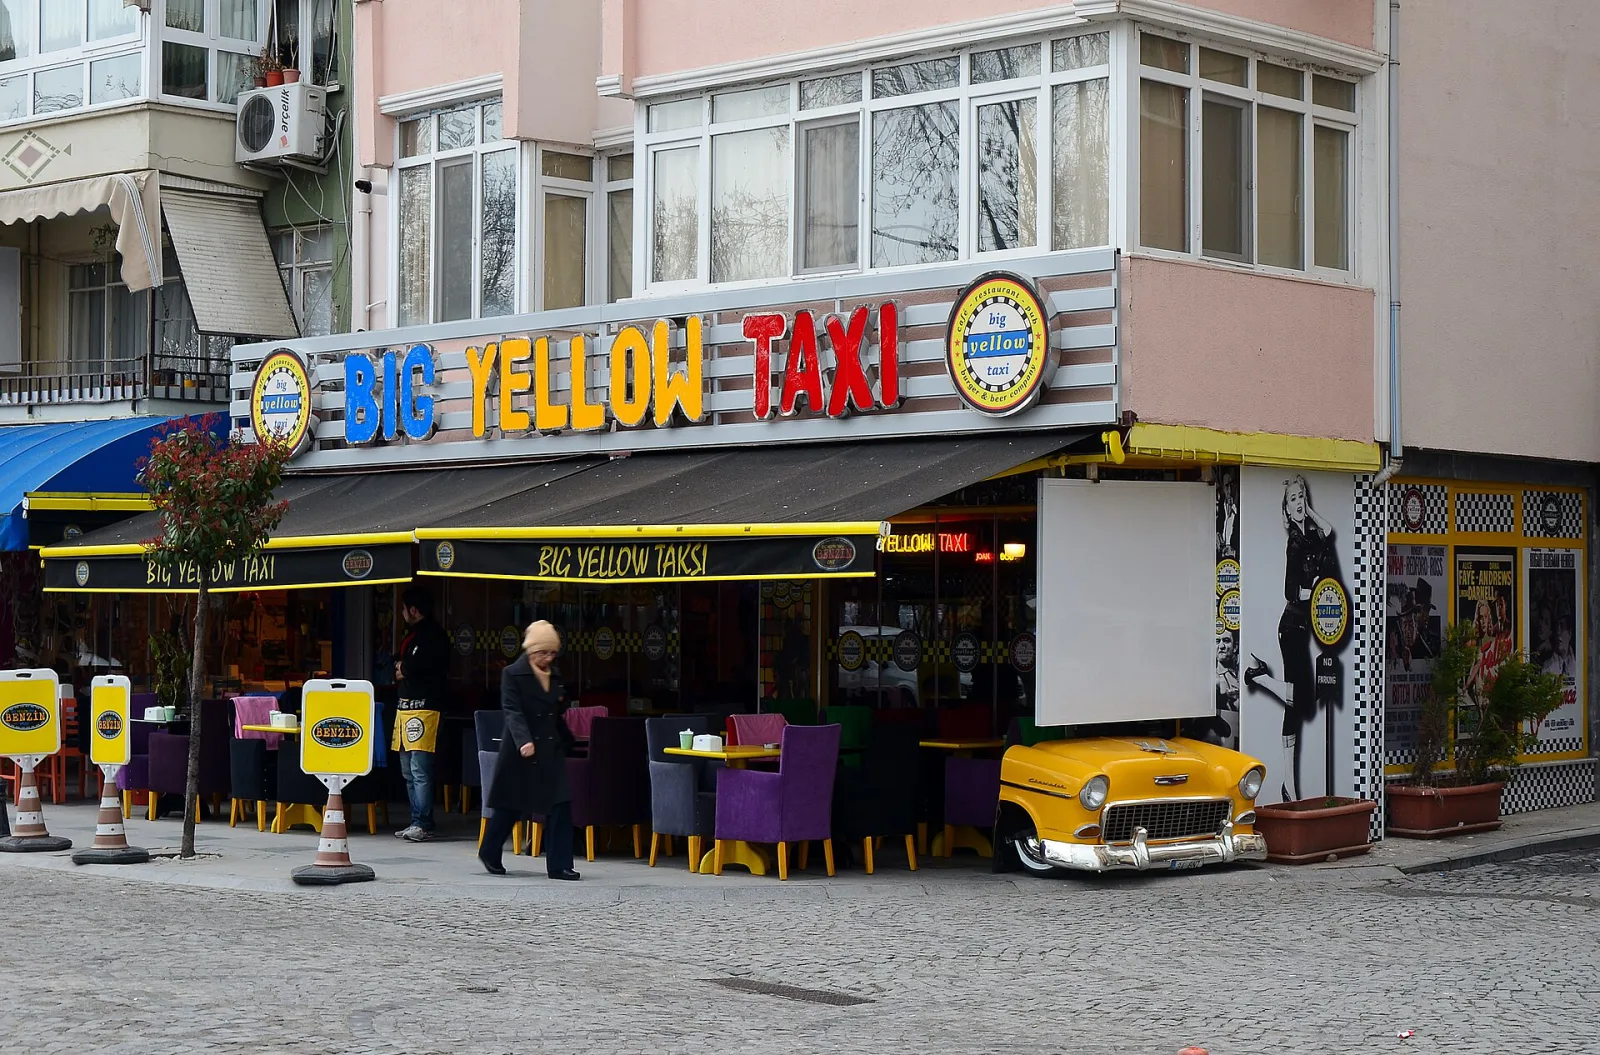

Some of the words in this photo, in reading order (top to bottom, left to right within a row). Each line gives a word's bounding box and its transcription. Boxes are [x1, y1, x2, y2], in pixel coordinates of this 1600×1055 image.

[281, 88, 290, 133] arçelik
[974, 287, 1020, 303] restaurant
[1025, 305, 1038, 325] pub
[989, 313, 1006, 328] big
[970, 335, 1026, 355] yellow
[344, 342, 437, 444] BIG
[465, 314, 705, 439] YELLOW
[741, 299, 901, 421] TAXI
[987, 363, 1010, 376] taxi
[276, 378, 287, 392] big
[960, 369, 980, 395] burger
[1009, 364, 1036, 398] company
[264, 396, 298, 412] yellow
[881, 533, 931, 552] YELLOW
[938, 532, 967, 552] TAXI
[538, 546, 571, 577] BIG
[577, 544, 649, 577] YELLOW
[655, 543, 708, 576] TAKSI
[179, 559, 235, 583] YELOW
[242, 554, 275, 582] TAXI
[1458, 570, 1475, 585] FAYE
[1478, 570, 1512, 586] ANDREWS
[1317, 605, 1340, 616] yellow
[1323, 658, 1333, 667] NO
[1317, 675, 1337, 685] PARKING
[5, 710, 46, 723] BENZİN
[315, 725, 359, 738] BENZİN
